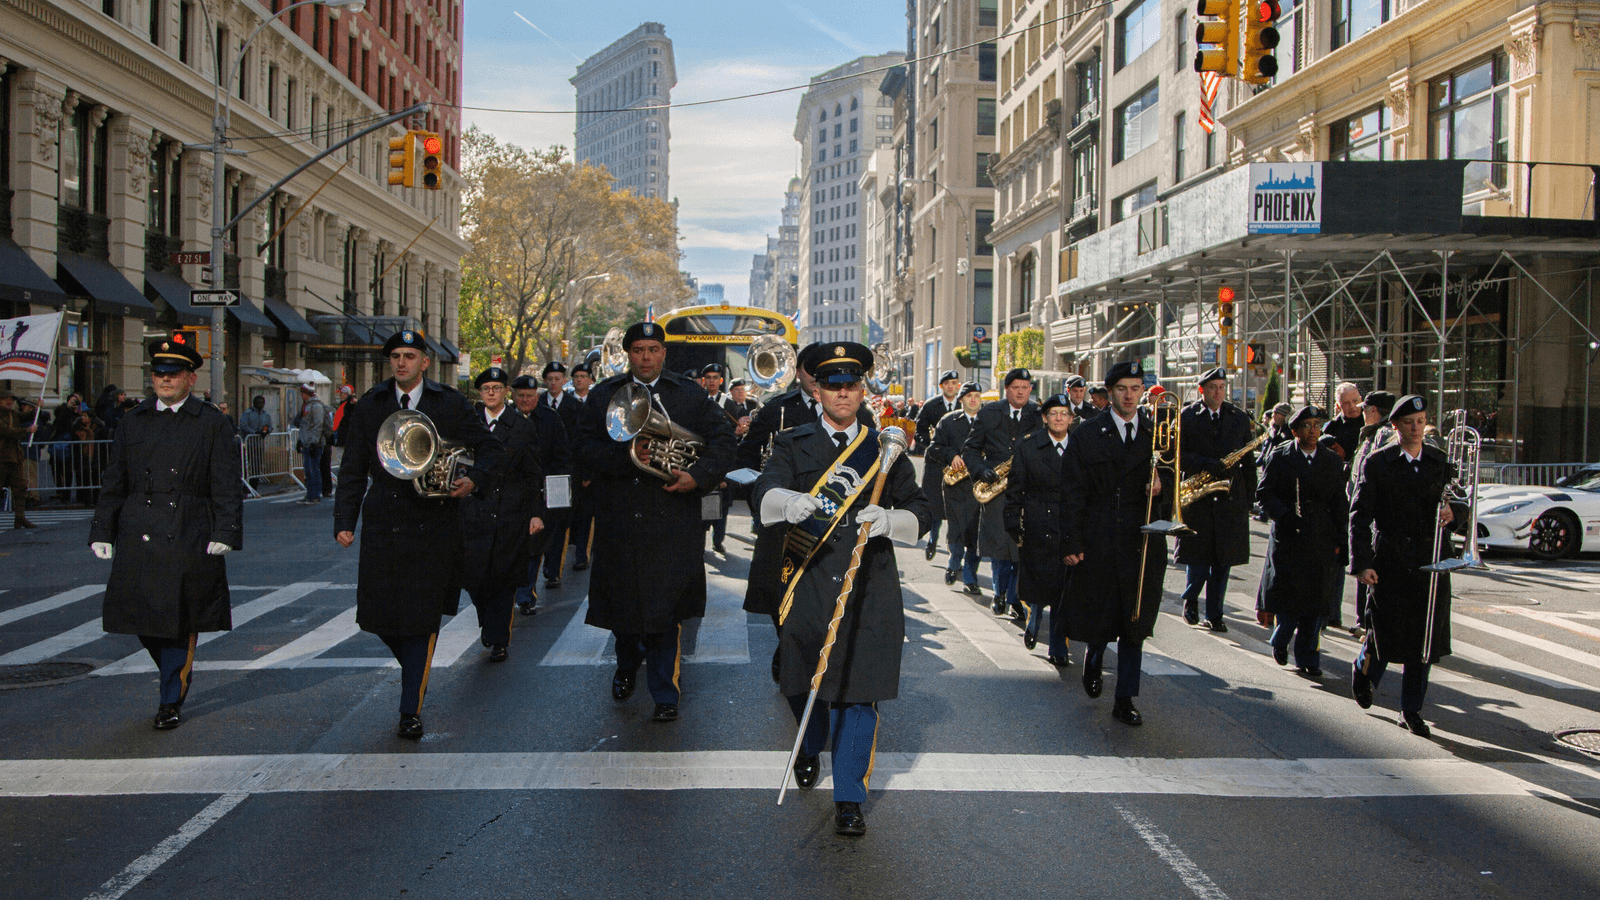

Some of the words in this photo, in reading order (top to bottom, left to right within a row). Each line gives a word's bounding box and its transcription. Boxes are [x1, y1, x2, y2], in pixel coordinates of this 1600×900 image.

[1254, 192, 1316, 221] PHOENIX
[178, 255, 182, 263] E
[184, 254, 192, 263] 27
[194, 254, 202, 263] St
[197, 294, 211, 302] ONE
[218, 294, 233, 302] WAY
